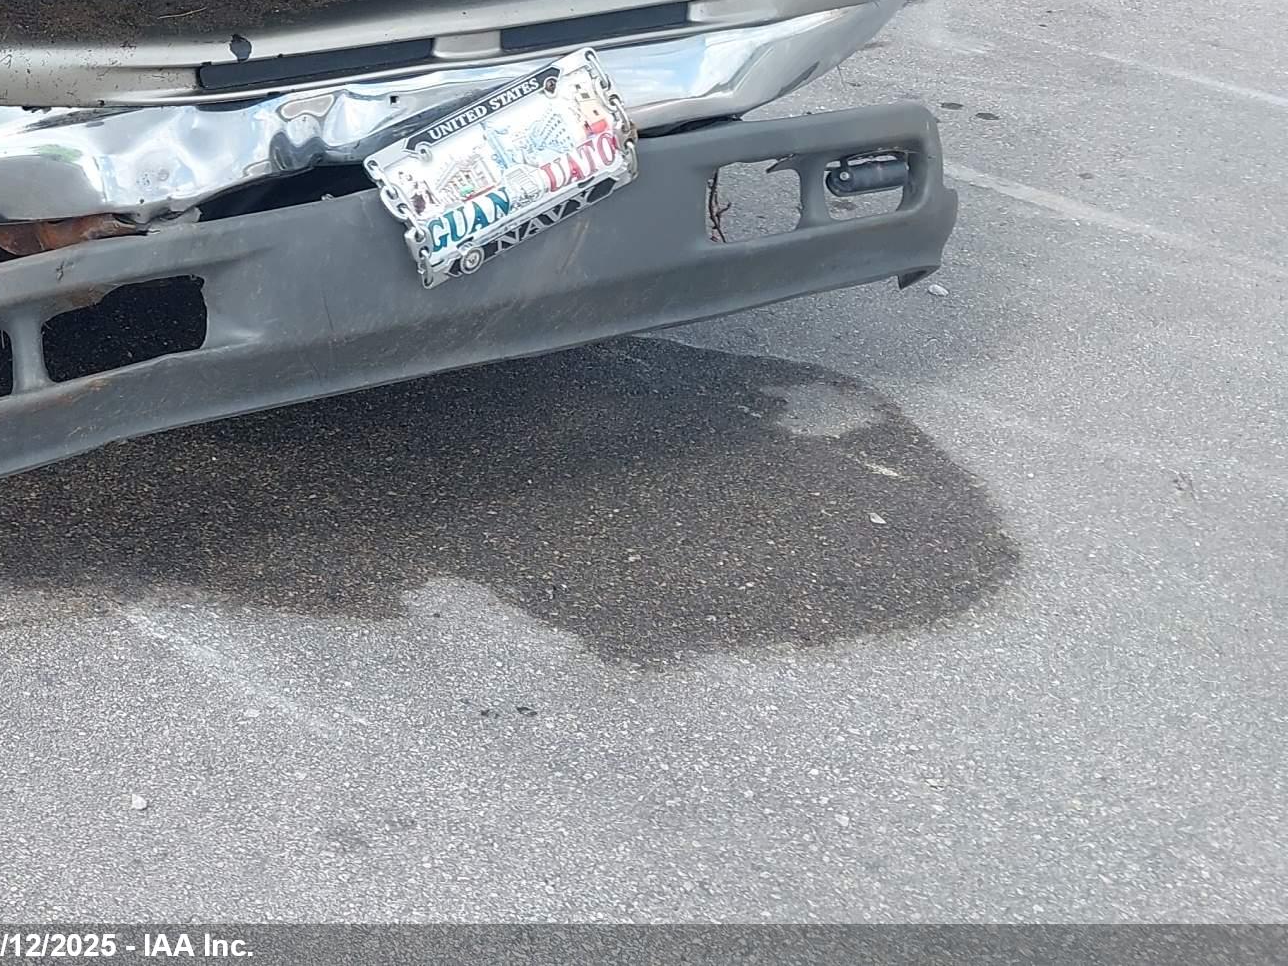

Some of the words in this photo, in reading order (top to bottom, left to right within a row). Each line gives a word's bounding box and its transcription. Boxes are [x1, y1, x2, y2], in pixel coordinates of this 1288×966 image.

[427, 106, 488, 140] UNITED
[488, 77, 539, 110] STATES
[427, 186, 511, 253] GUAN
[493, 186, 596, 255] NAVY
